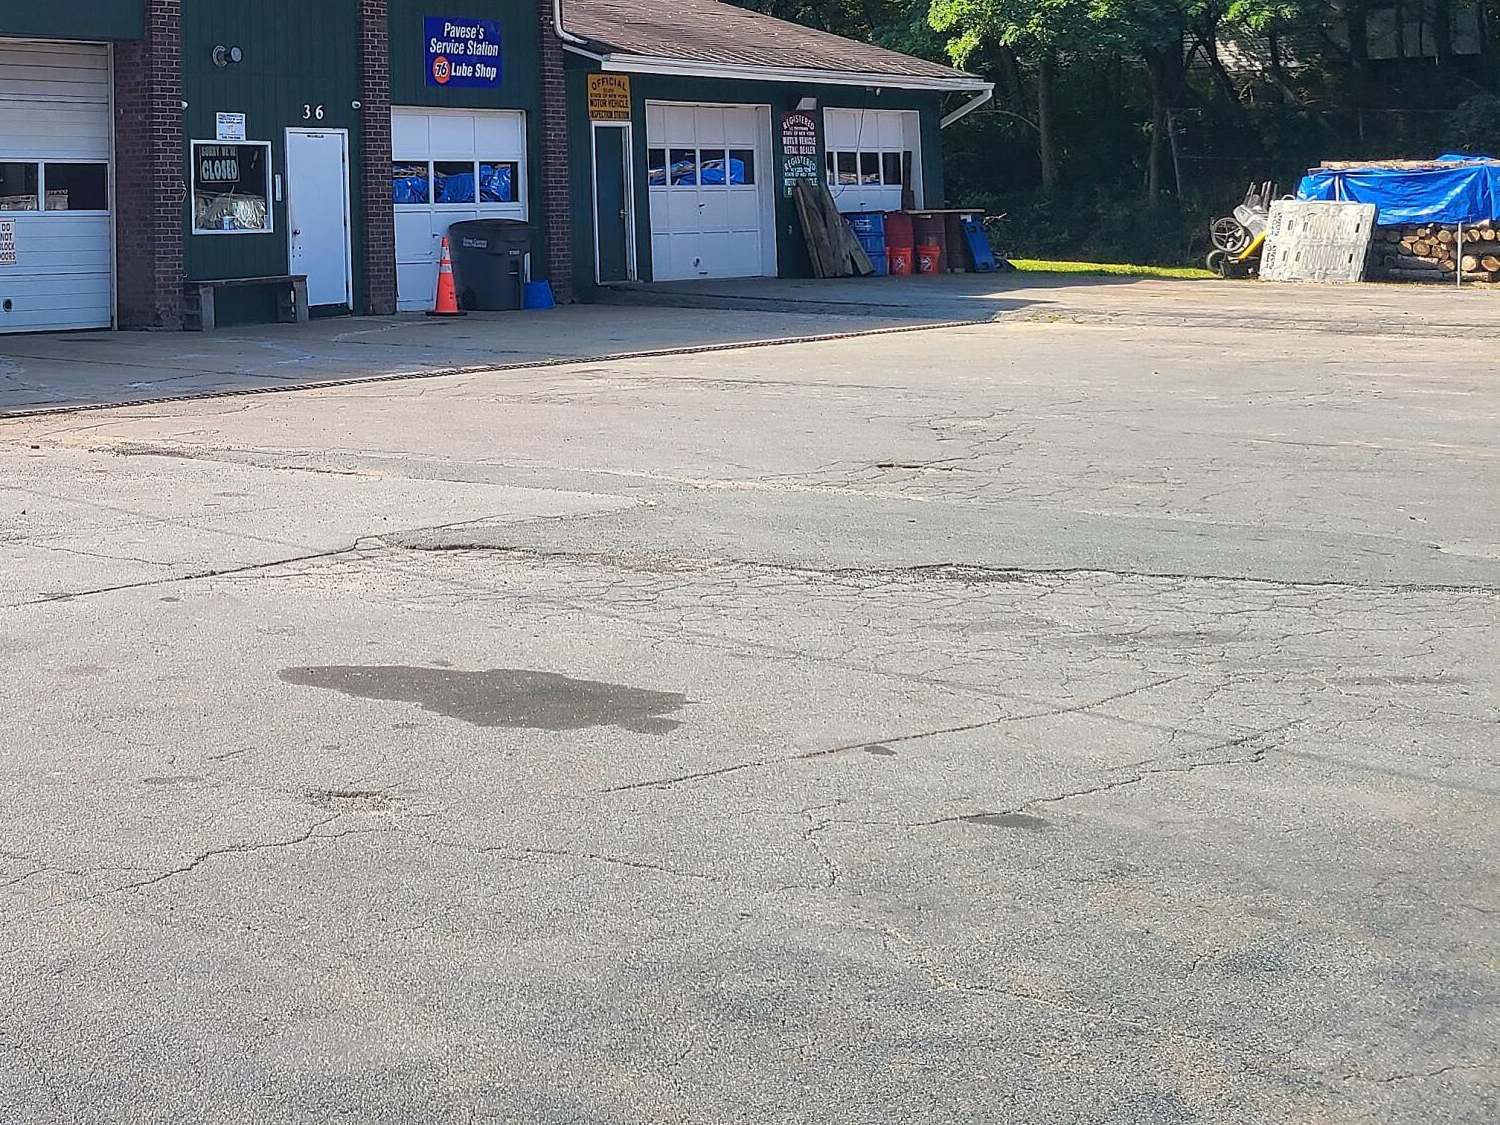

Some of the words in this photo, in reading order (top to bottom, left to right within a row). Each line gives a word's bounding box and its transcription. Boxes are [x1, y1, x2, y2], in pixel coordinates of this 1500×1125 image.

[444, 22, 485, 39] Pavese's
[430, 38, 465, 54] Service
[467, 40, 499, 56] Station
[435, 61, 448, 77] 76
[451, 62, 473, 77] Lube
[475, 63, 497, 81] Shop
[591, 77, 627, 92] OFFICIAL
[590, 99, 607, 107] MOTOR
[608, 99, 629, 108] VEHICLE
[782, 115, 815, 131] REGISTERED
[799, 136, 816, 146] VEHICLE
[799, 146, 816, 155] DEALER
[202, 159, 237, 180] CLOSED
[784, 156, 816, 171] REGISTERED
[2, 223, 10, 231] DO
[0, 232, 12, 241] NOT
